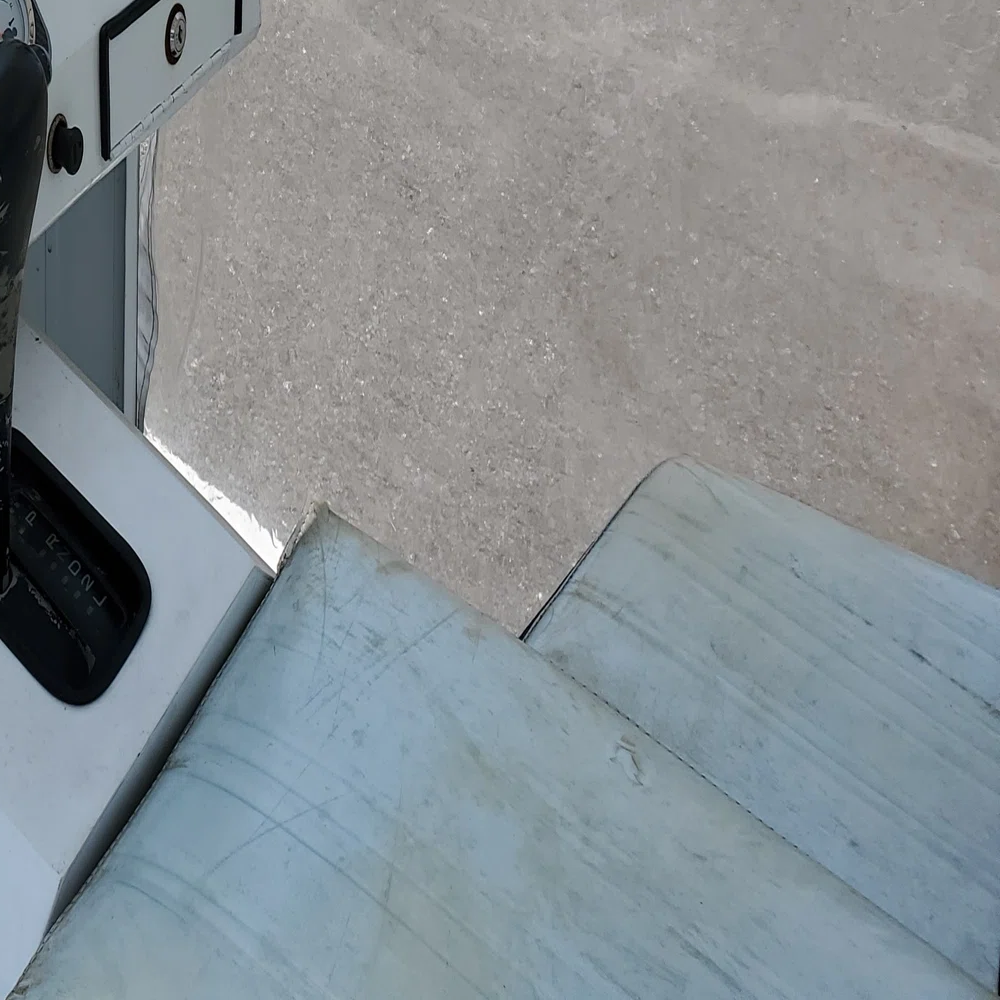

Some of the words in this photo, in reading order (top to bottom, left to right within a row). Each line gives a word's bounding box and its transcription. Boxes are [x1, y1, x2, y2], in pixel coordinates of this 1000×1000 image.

[25, 510, 37, 527] P
[45, 533, 60, 551] R
[56, 546, 72, 562] N
[67, 560, 81, 576] D
[81, 574, 95, 592] 2
[92, 595, 108, 607] L
